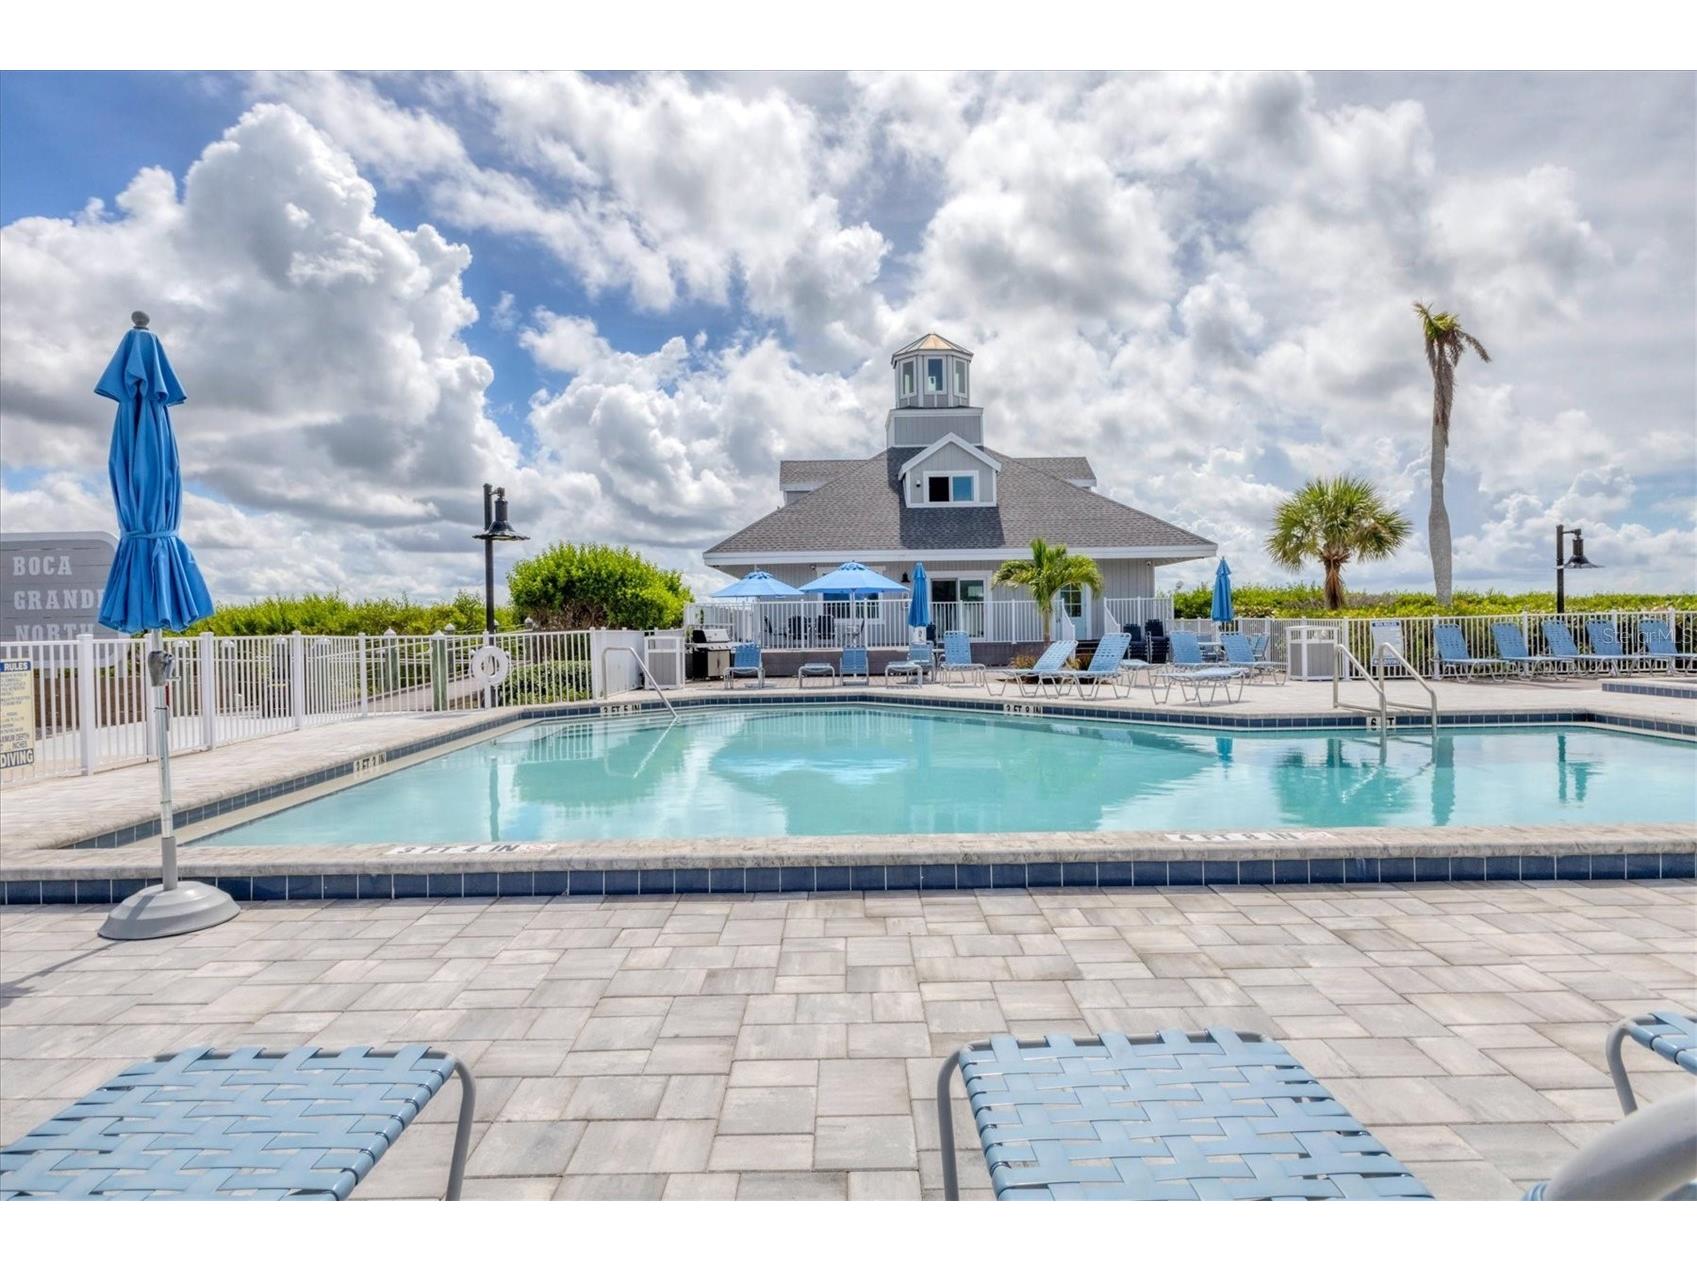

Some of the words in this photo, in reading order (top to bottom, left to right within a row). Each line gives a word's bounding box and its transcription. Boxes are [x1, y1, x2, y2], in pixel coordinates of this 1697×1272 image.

[13, 556, 72, 576] BOCA
[15, 623, 95, 641] NORTH
[4, 661, 29, 671] RULES
[0, 750, 33, 767] DIVING
[489, 844, 521, 852] IN
